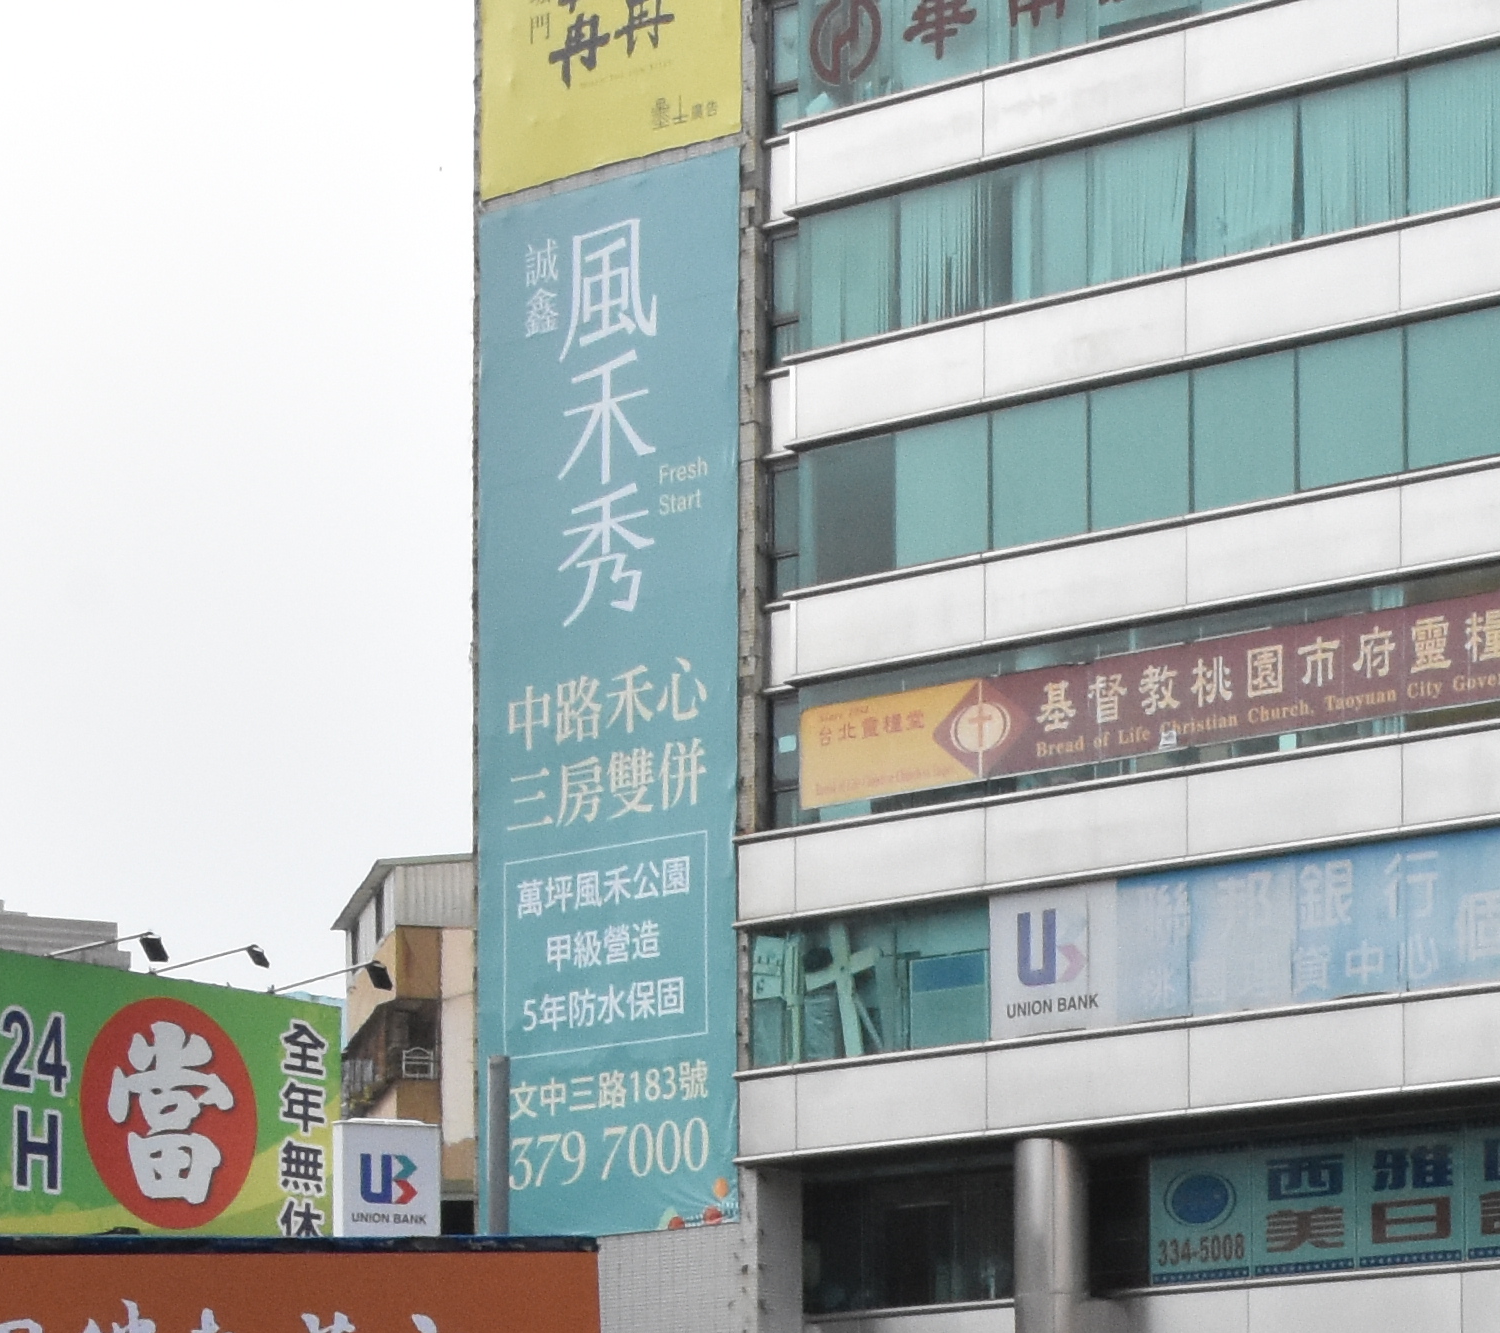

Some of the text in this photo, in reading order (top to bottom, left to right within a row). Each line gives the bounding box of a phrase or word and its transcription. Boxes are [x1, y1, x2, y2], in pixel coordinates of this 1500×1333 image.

[525, 238, 560, 338] 誠鑫
[558, 217, 658, 628] 風禾秀
[659, 456, 708, 484] Fresh
[659, 488, 702, 515] Start
[507, 656, 708, 752] 中路禾心
[1035, 735, 1085, 758] Bread
[1093, 731, 1111, 748] of
[1117, 725, 1151, 745] Life
[1160, 712, 1239, 738] Christian
[1247, 700, 1316, 724] Church,
[1325, 688, 1397, 716] Taoyuan
[1407, 676, 1443, 702] City
[506, 736, 708, 832] 三房雙併
[516, 855, 692, 919] 萬坪風禾公園
[545, 920, 661, 973] 甲級營造
[522, 976, 685, 1032] 5年防水保固
[1006, 993, 1099, 1019] UNION BANK
[509, 1058, 710, 1121] 文中三路183號
[12, 1105, 62, 1195] H
[279, 1018, 329, 1237] 全年無休
[508, 1117, 711, 1191] 379 7000
[351, 1211, 428, 1226] UNION BANK
[1157, 1231, 1245, 1268] 334-5008
